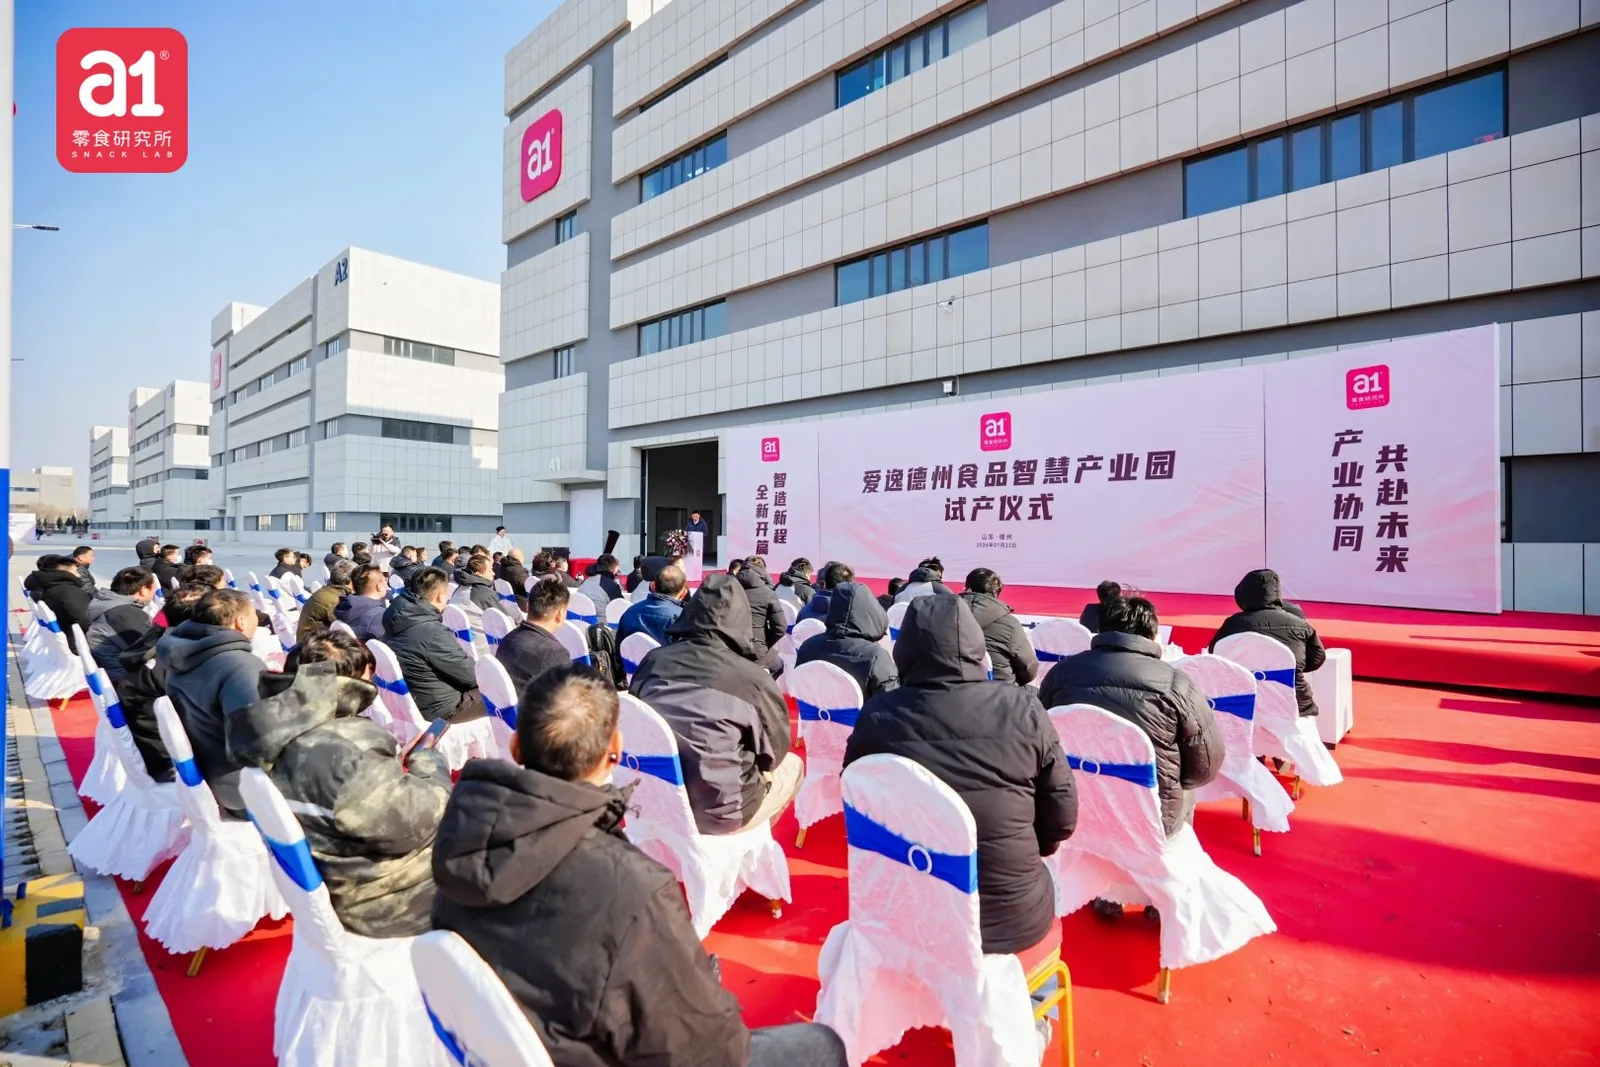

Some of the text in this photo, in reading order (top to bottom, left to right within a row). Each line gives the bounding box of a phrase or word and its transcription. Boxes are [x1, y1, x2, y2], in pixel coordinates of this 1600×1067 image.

[527, 131, 553, 180] a1
[335, 257, 348, 286] A2
[1353, 372, 1382, 393] a1
[764, 441, 777, 453] a1
[985, 418, 1006, 437] a1
[862, 450, 1176, 493] 爱逸德州食品智慧产业园
[1332, 429, 1364, 551] 产业协同
[755, 484, 769, 555] 全新开篇
[773, 472, 787, 544] 智造新程
[944, 493, 1055, 522] 试产仪式
[1375, 444, 1409, 573] 共赴未来
